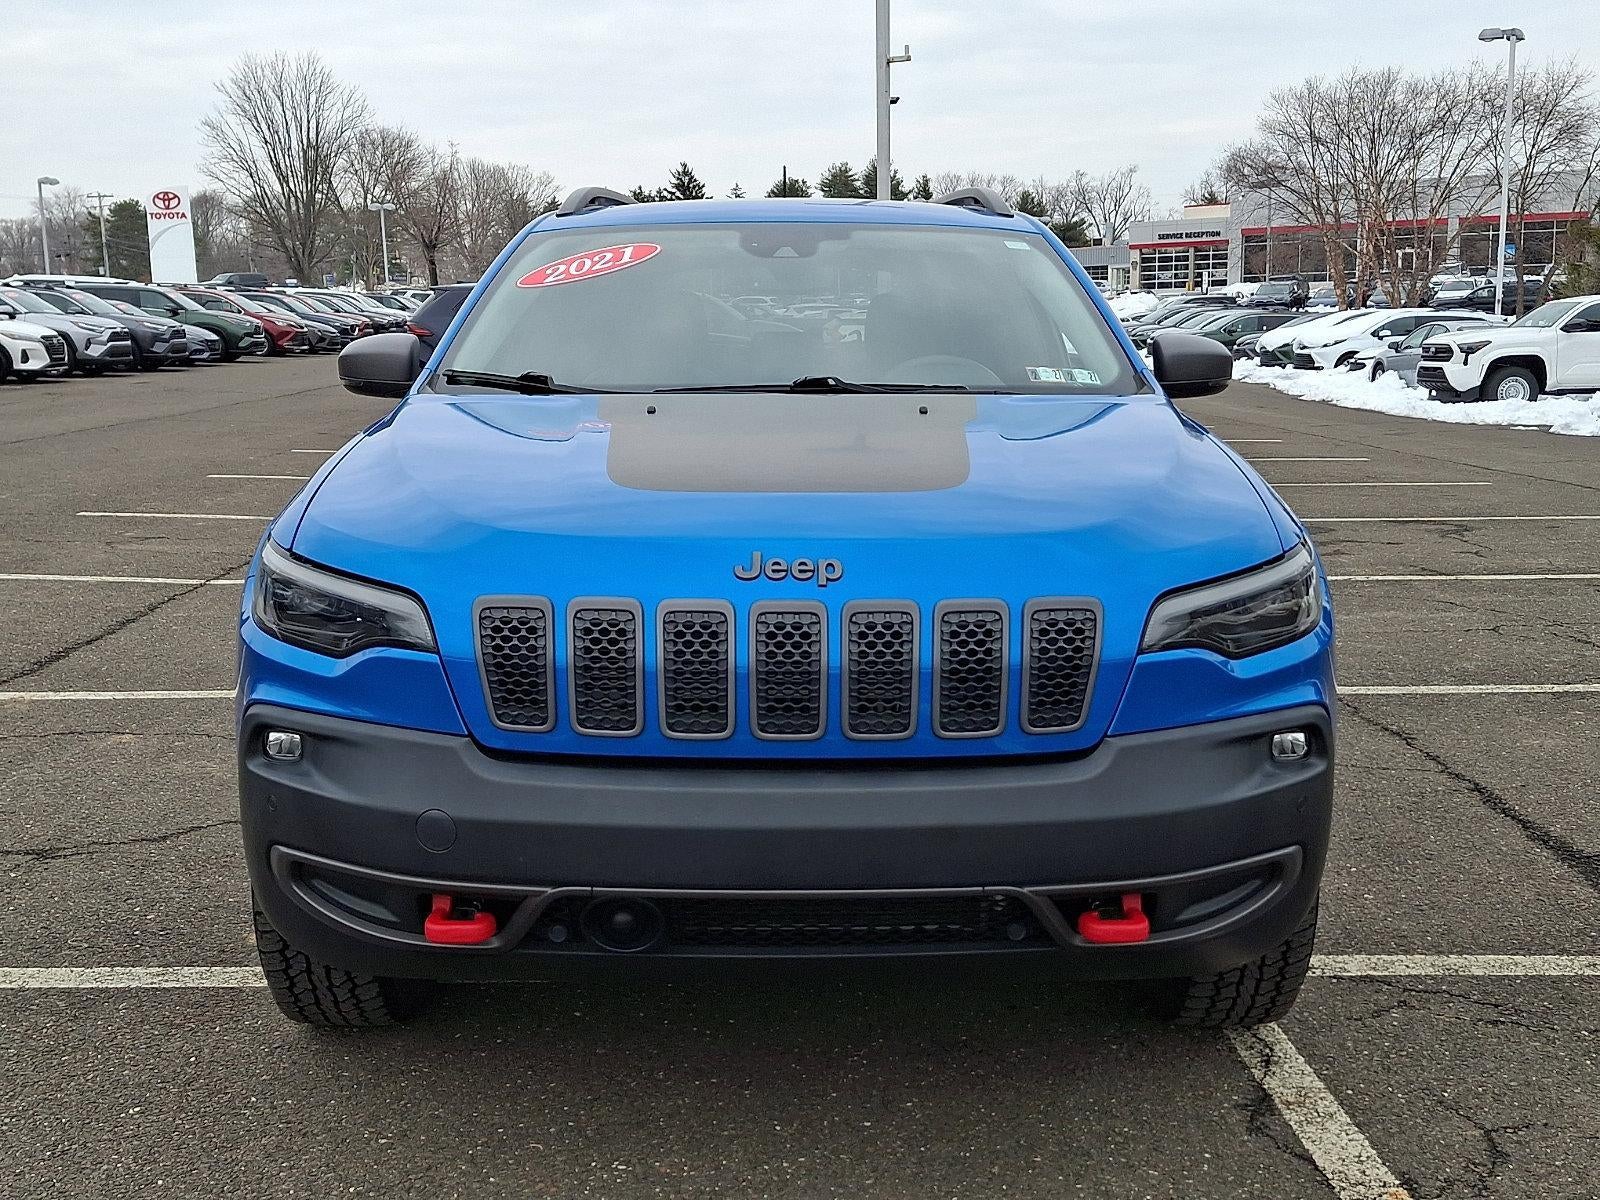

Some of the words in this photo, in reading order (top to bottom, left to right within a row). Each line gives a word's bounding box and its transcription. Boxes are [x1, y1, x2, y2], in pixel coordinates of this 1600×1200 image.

[149, 212, 187, 220] TOYOTA
[1158, 232, 1183, 240] SERVICE
[1185, 230, 1221, 239] RECEPTION
[543, 246, 634, 283] 2021
[734, 551, 844, 587] Jeep
